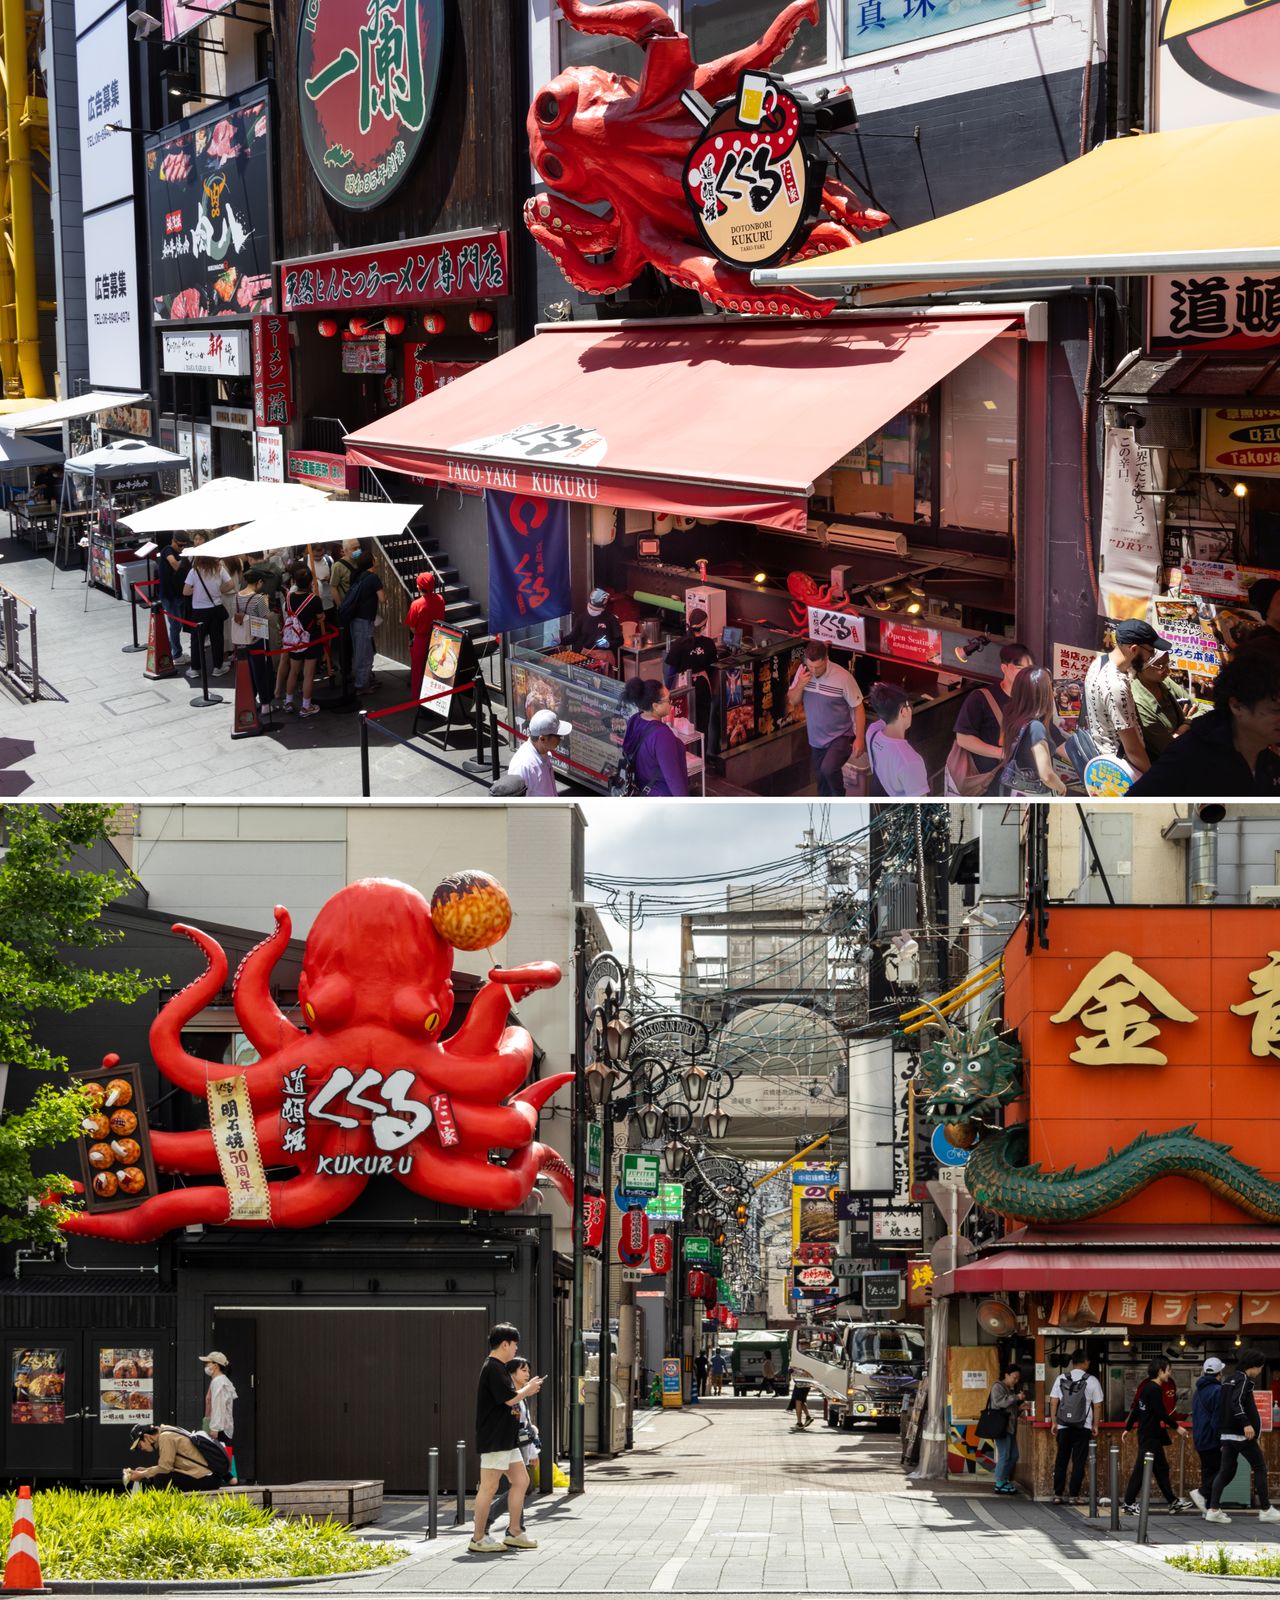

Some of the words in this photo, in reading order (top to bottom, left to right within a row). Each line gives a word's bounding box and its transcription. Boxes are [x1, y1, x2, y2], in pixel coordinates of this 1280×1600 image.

[87, 78, 120, 122] 広告募集
[730, 220, 772, 234] DOTONBORI
[731, 230, 773, 246] KUKURU
[94, 270, 127, 301] 広告募集
[284, 243, 504, 307] 天然とんこつラーメン専門店
[267, 318, 289, 424] ラーメン一蘭
[446, 461, 517, 488] TAKO-YAKI
[532, 472, 598, 499] KUKURU
[1118, 437, 1131, 483] この辛口。
[887, 631, 907, 643] Open
[907, 635, 935, 649] Seating
[281, 1064, 308, 1154] 道頓堀
[308, 1066, 433, 1151] くくる
[433, 1096, 459, 1146] たこ家
[316, 1154, 413, 1175] KUKURU
